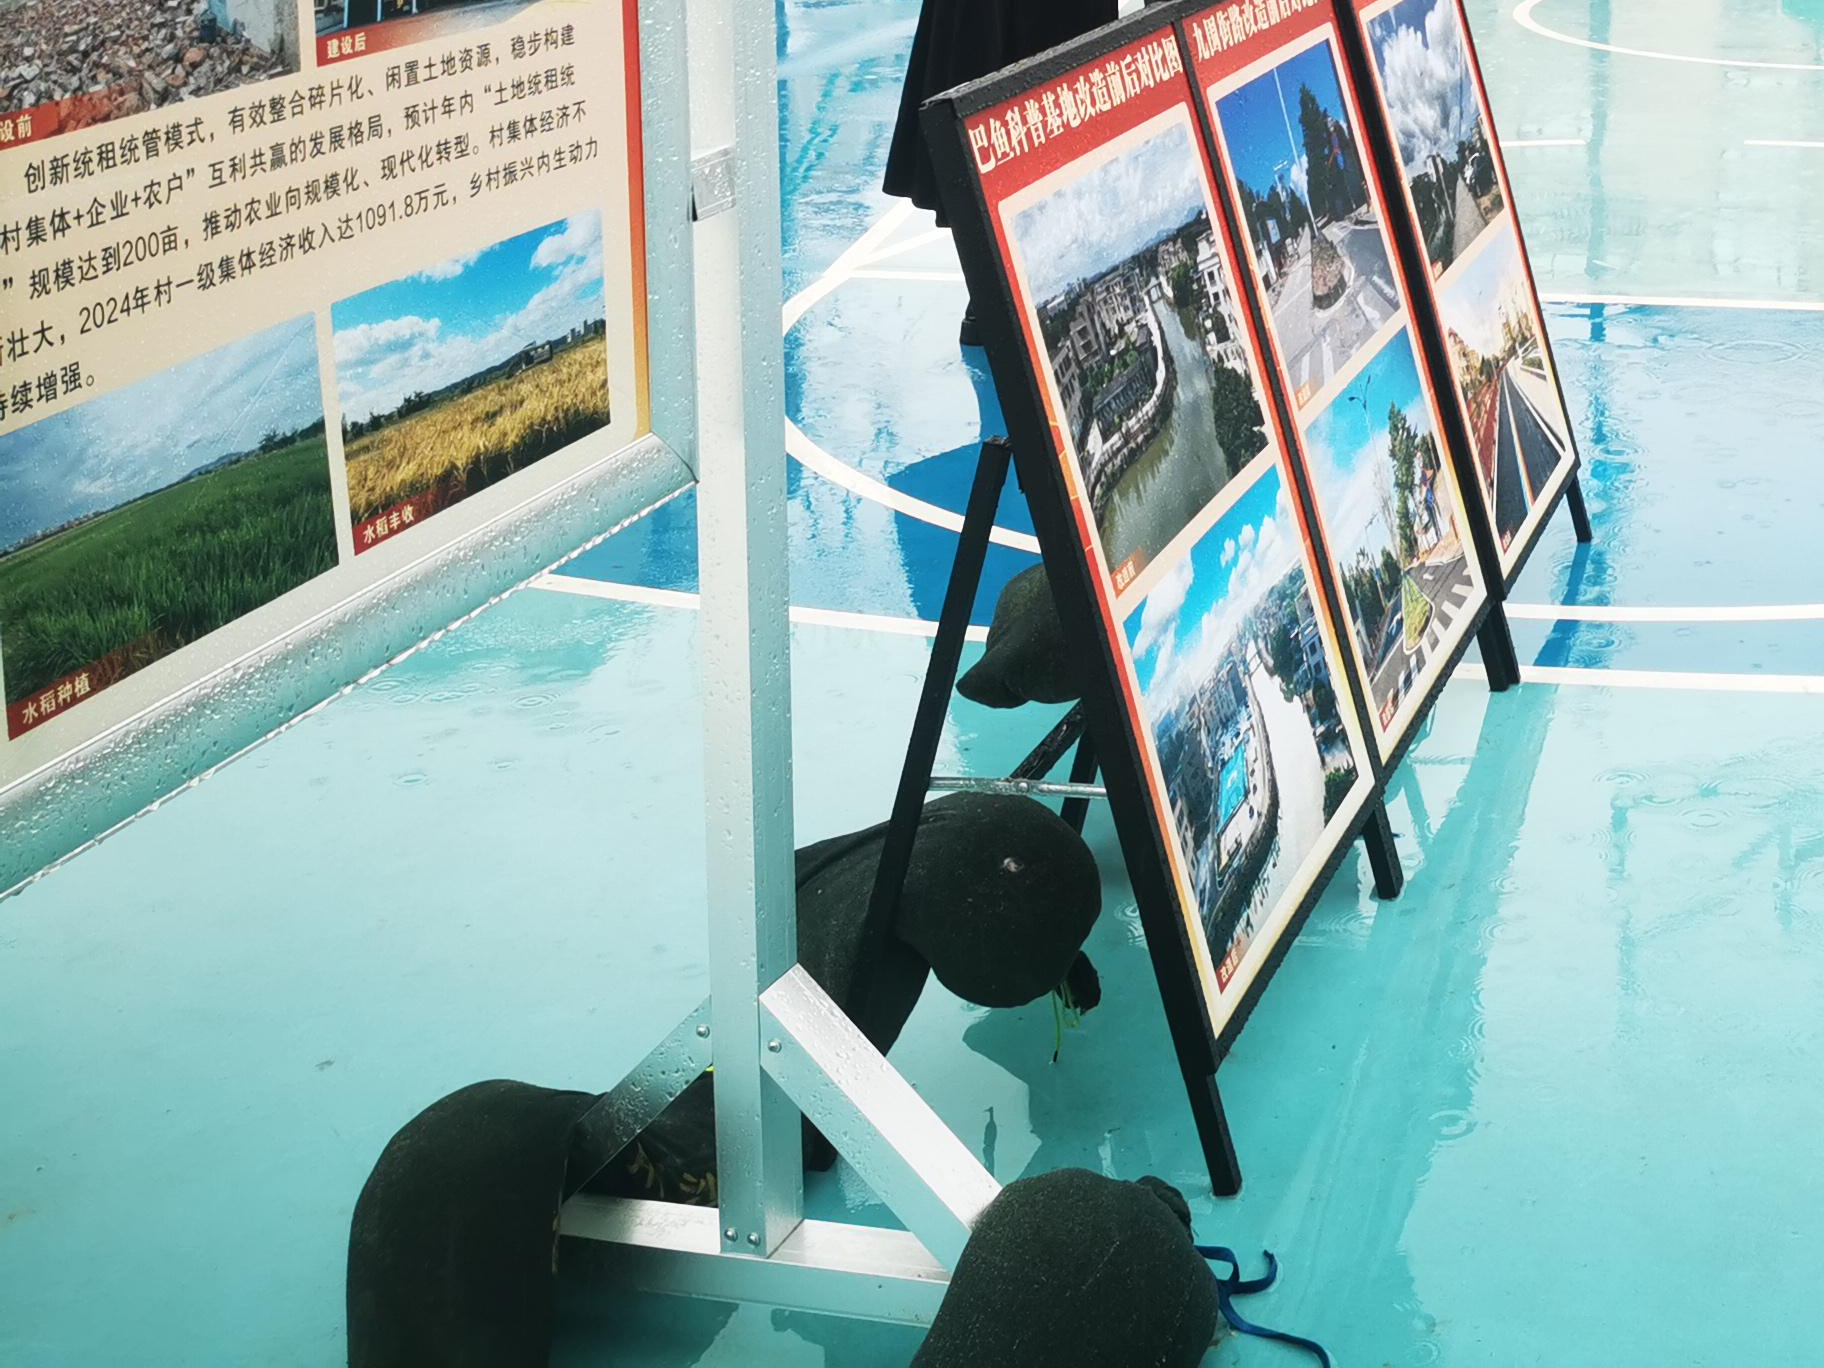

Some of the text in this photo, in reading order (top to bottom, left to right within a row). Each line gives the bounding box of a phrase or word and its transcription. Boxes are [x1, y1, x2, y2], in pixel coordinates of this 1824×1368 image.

[326, 31, 366, 59] 建设后
[967, 33, 1184, 175] 巴鱼科普基地改造前后对比图
[362, 503, 415, 544] 水稻丰收
[21, 671, 92, 724] 水稻种植
